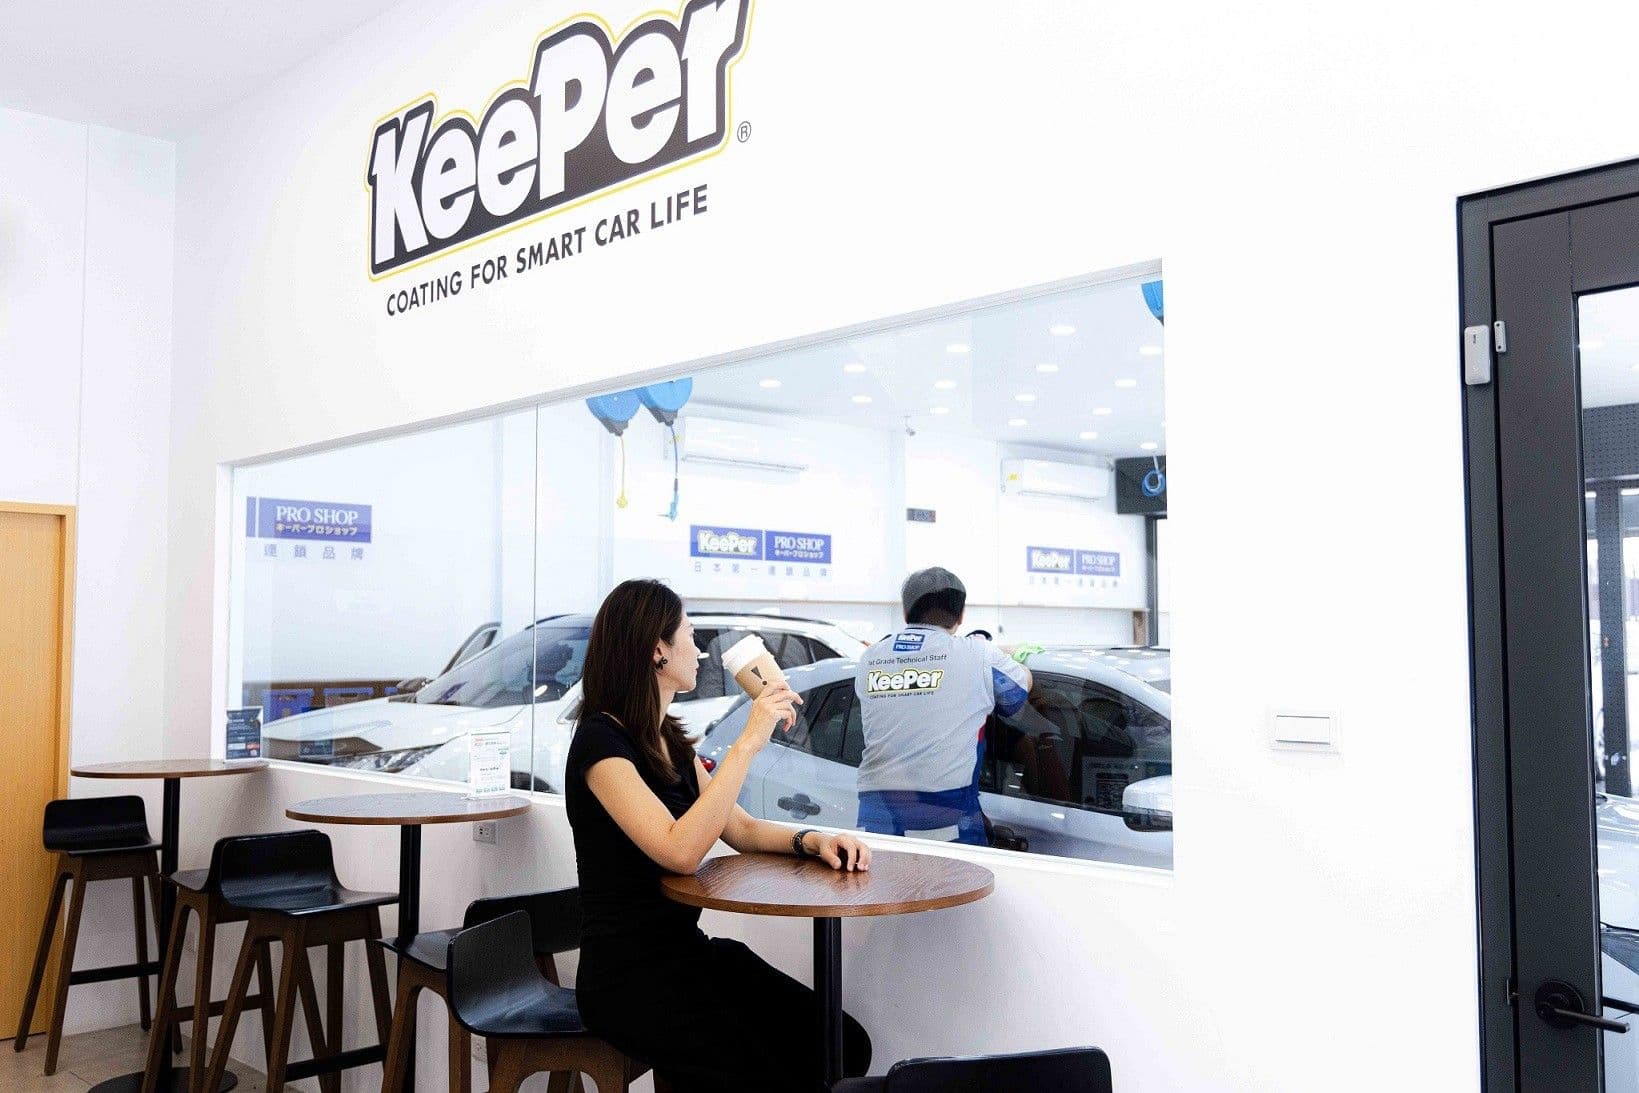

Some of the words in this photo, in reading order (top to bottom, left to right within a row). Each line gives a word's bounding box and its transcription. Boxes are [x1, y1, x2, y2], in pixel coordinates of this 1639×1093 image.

[369, 0, 752, 268] KeePer
[386, 270, 463, 317] COATING
[471, 255, 508, 290] FOR
[516, 226, 587, 274] SMART
[594, 208, 641, 247] CAR
[650, 183, 708, 230] LIFE
[276, 506, 311, 522] PRO
[314, 508, 358, 525] SHOP
[697, 529, 757, 555] KeePer
[774, 535, 795, 549] PRO
[796, 537, 825, 551] SHOP
[896, 655, 928, 665] Technical
[868, 669, 943, 692] KeePer
